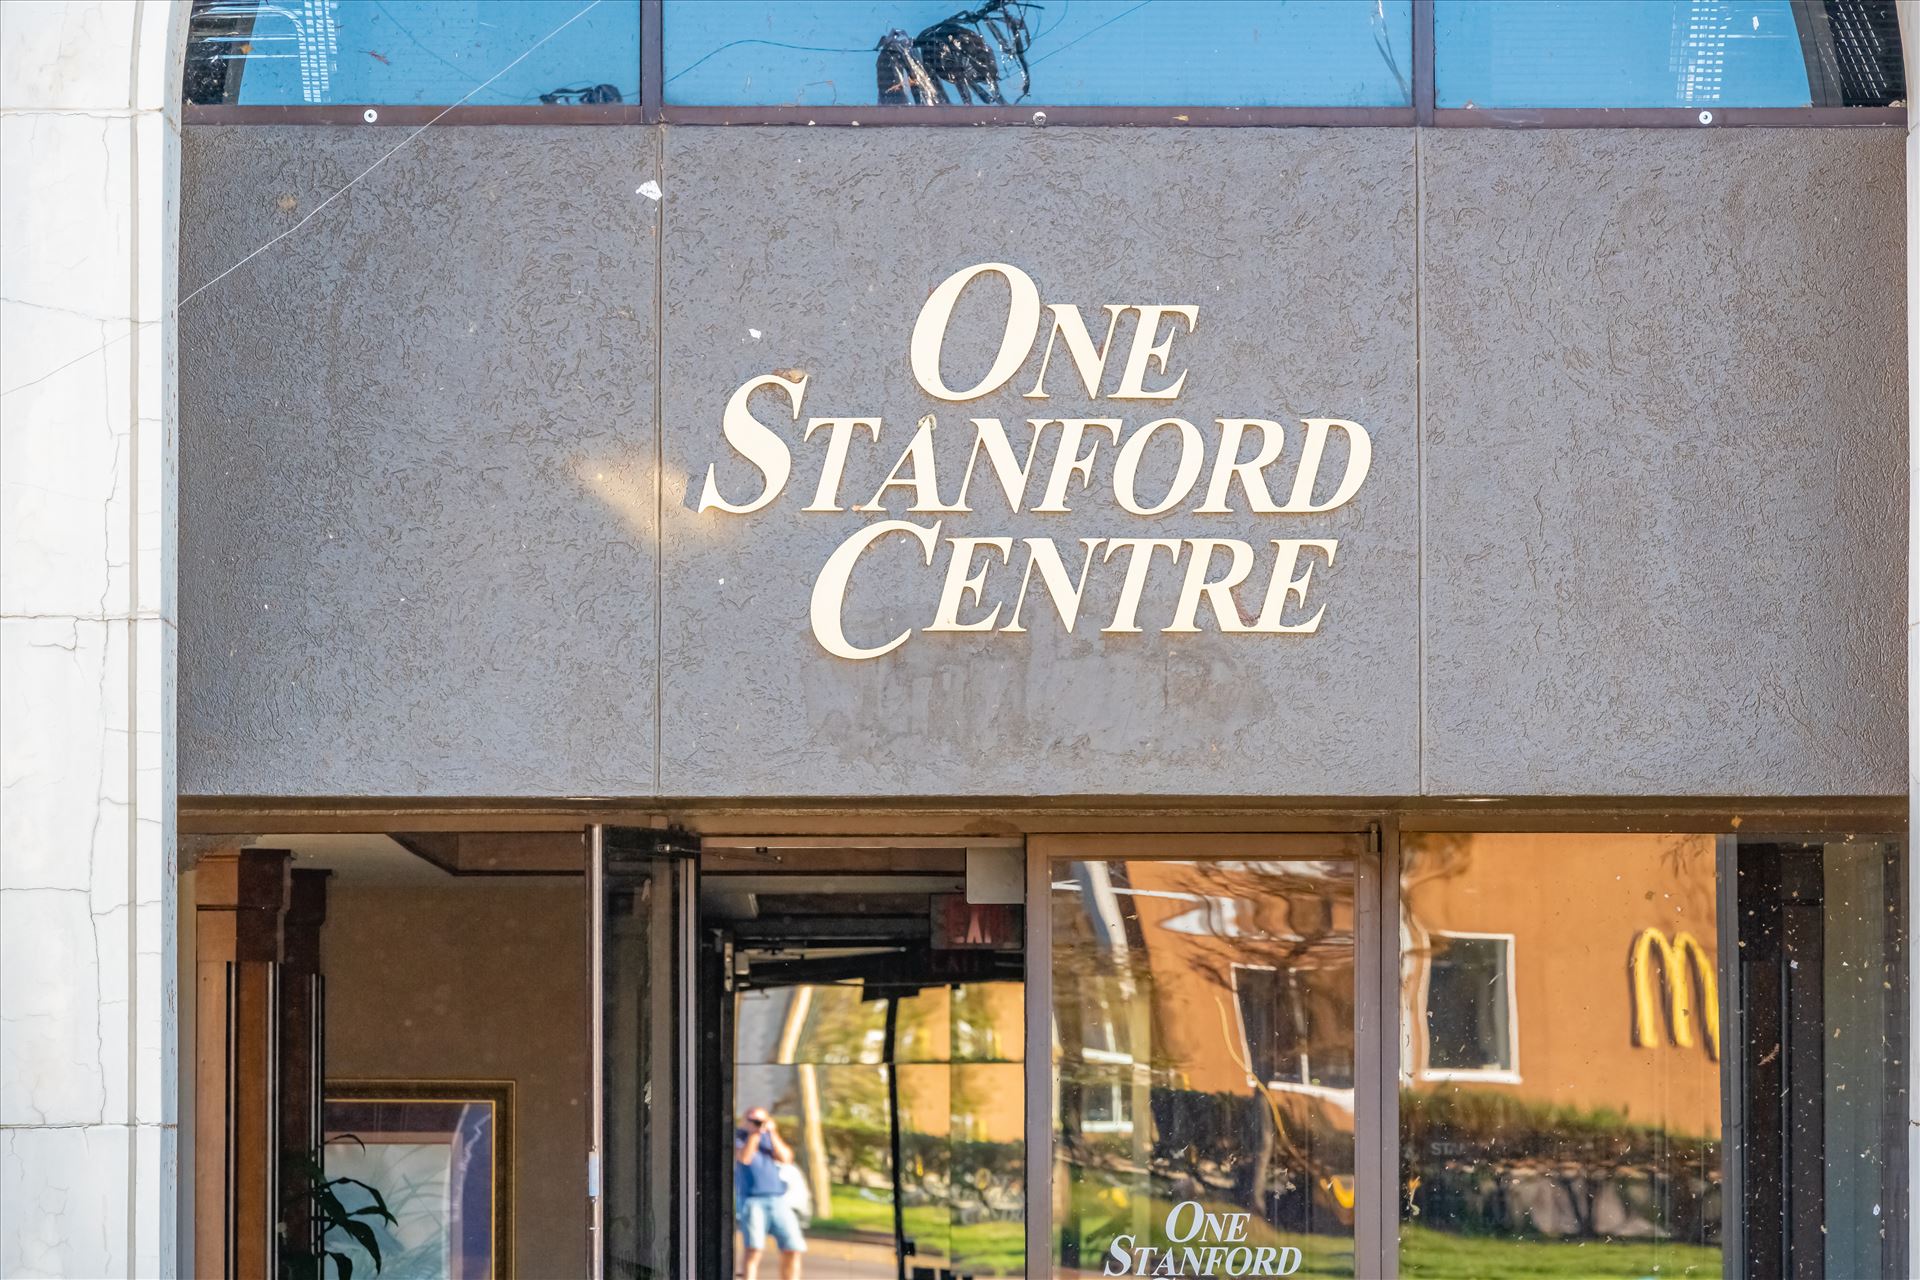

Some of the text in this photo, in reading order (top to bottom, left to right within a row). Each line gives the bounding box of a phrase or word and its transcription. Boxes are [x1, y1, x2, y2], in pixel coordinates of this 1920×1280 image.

[910, 262, 1200, 401] ONE
[697, 373, 1373, 515] STANFORD
[810, 519, 1339, 660] CENTRE
[1103, 1234, 1302, 1277] STANFORD
[1165, 1200, 1251, 1243] ONE
